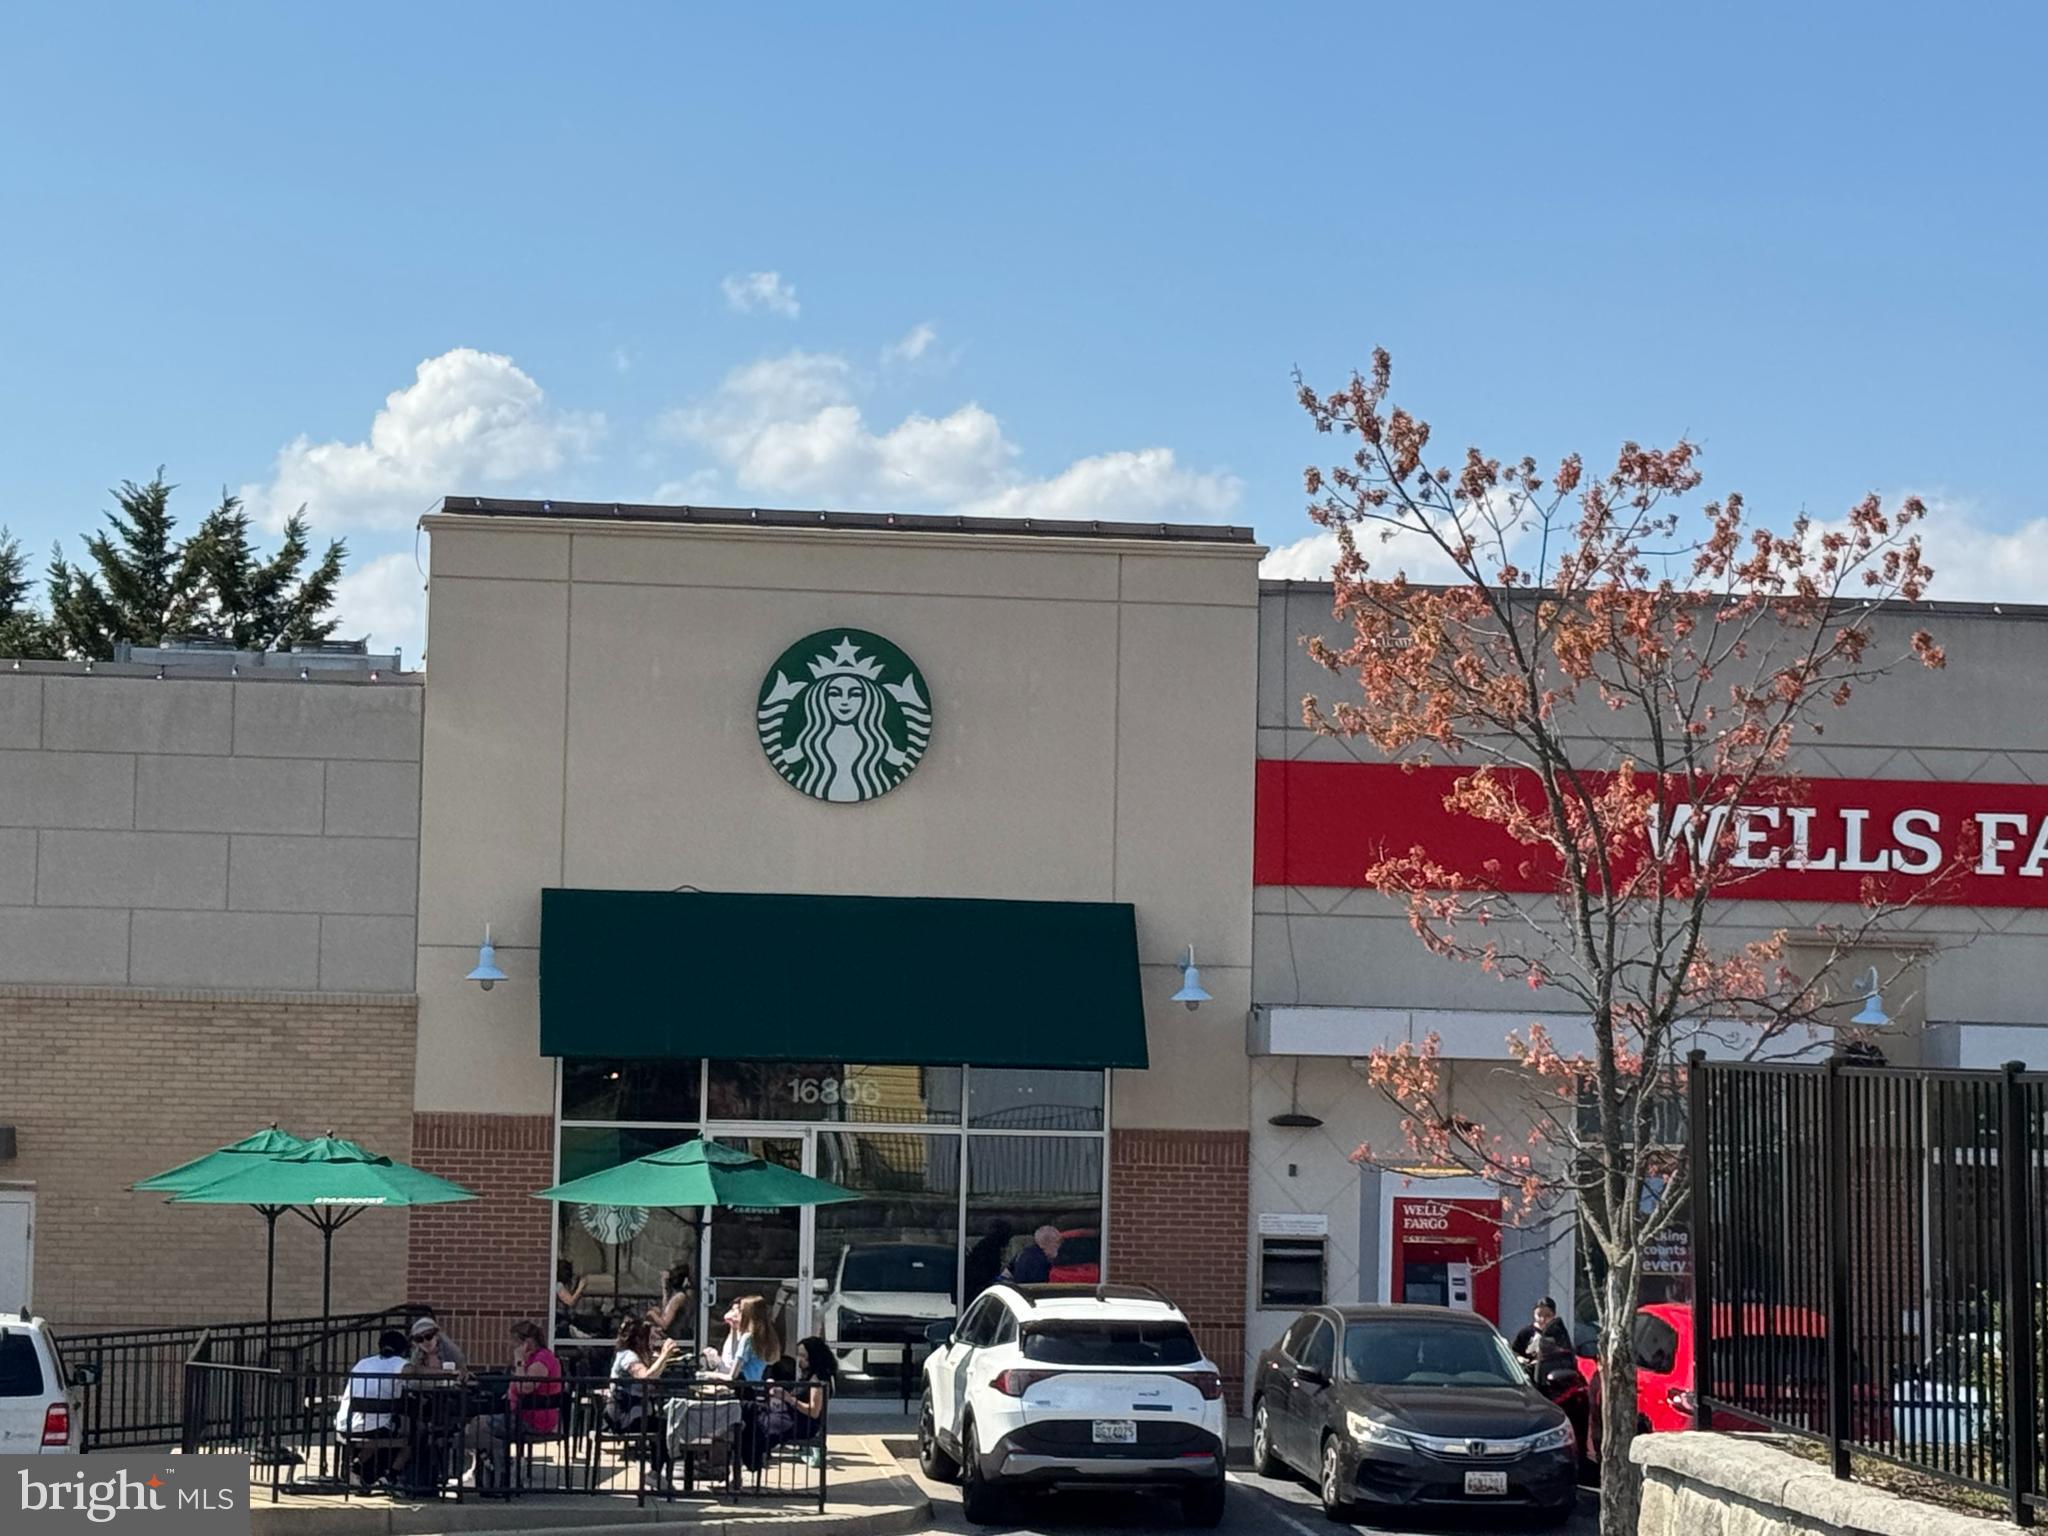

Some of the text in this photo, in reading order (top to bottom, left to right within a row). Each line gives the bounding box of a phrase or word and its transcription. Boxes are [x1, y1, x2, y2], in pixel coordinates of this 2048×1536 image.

[1646, 803, 1942, 875] WELLS
[788, 1078, 881, 1106] 16806
[1403, 1204, 1448, 1217] WELLS
[1403, 1218, 1449, 1230] FARGO
[1642, 1260, 1687, 1274] every
